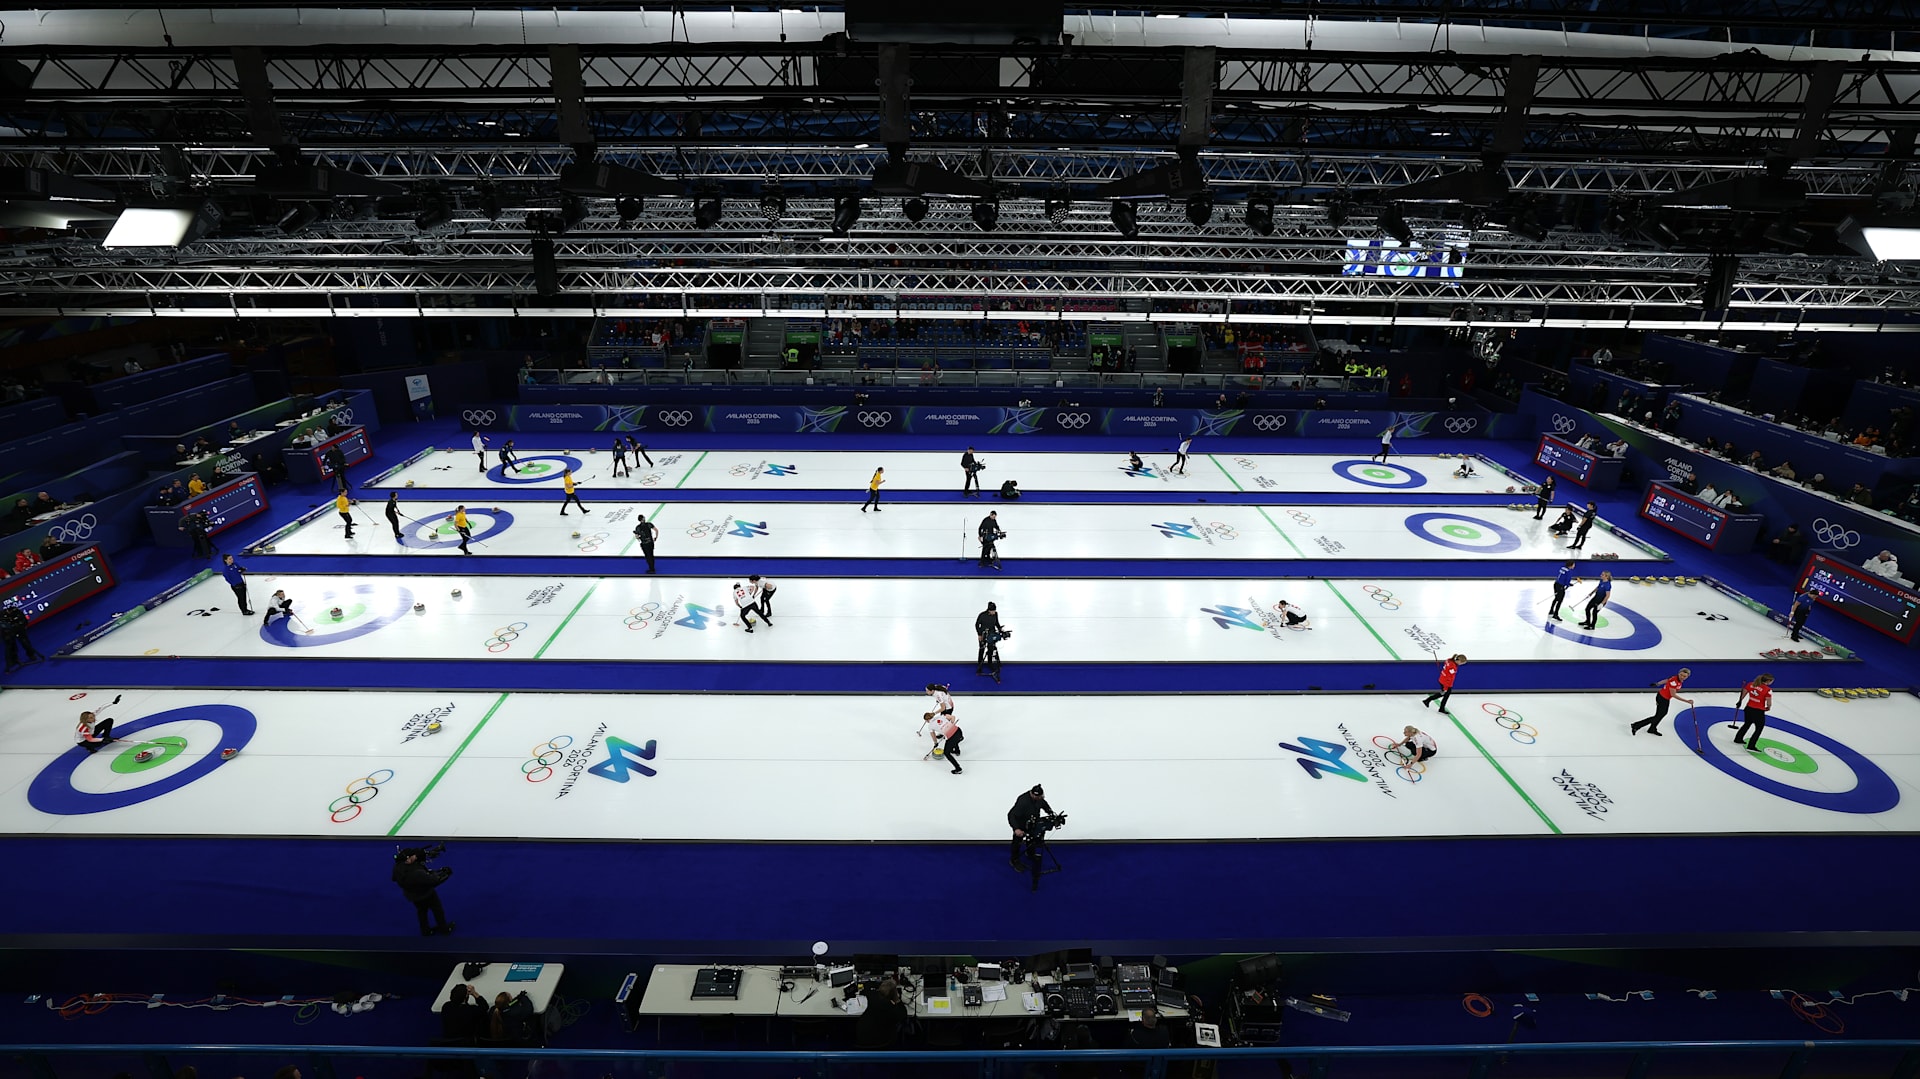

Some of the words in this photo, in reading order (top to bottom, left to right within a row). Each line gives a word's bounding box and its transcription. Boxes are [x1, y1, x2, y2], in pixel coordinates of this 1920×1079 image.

[215, 452, 241, 467] MILANO
[221, 458, 248, 473] CORTINA
[1664, 457, 1692, 472] MILANO
[1667, 465, 1690, 479] CORTIN
[95, 575, 102, 584] 0
[1904, 593, 1920, 605] OMEG
[1895, 622, 1903, 632] 0
[401, 713, 425, 731] 2026
[581, 721, 608, 758] MILANO
[1337, 722, 1367, 759] CORTINA
[562, 749, 582, 768] 2026
[1367, 749, 1386, 768] 2026
[555, 759, 588, 800] CORTINA
[1361, 758, 1397, 800] MILANO
[1552, 776, 1606, 822] MILANO
[1561, 768, 1608, 813] CORTINA
